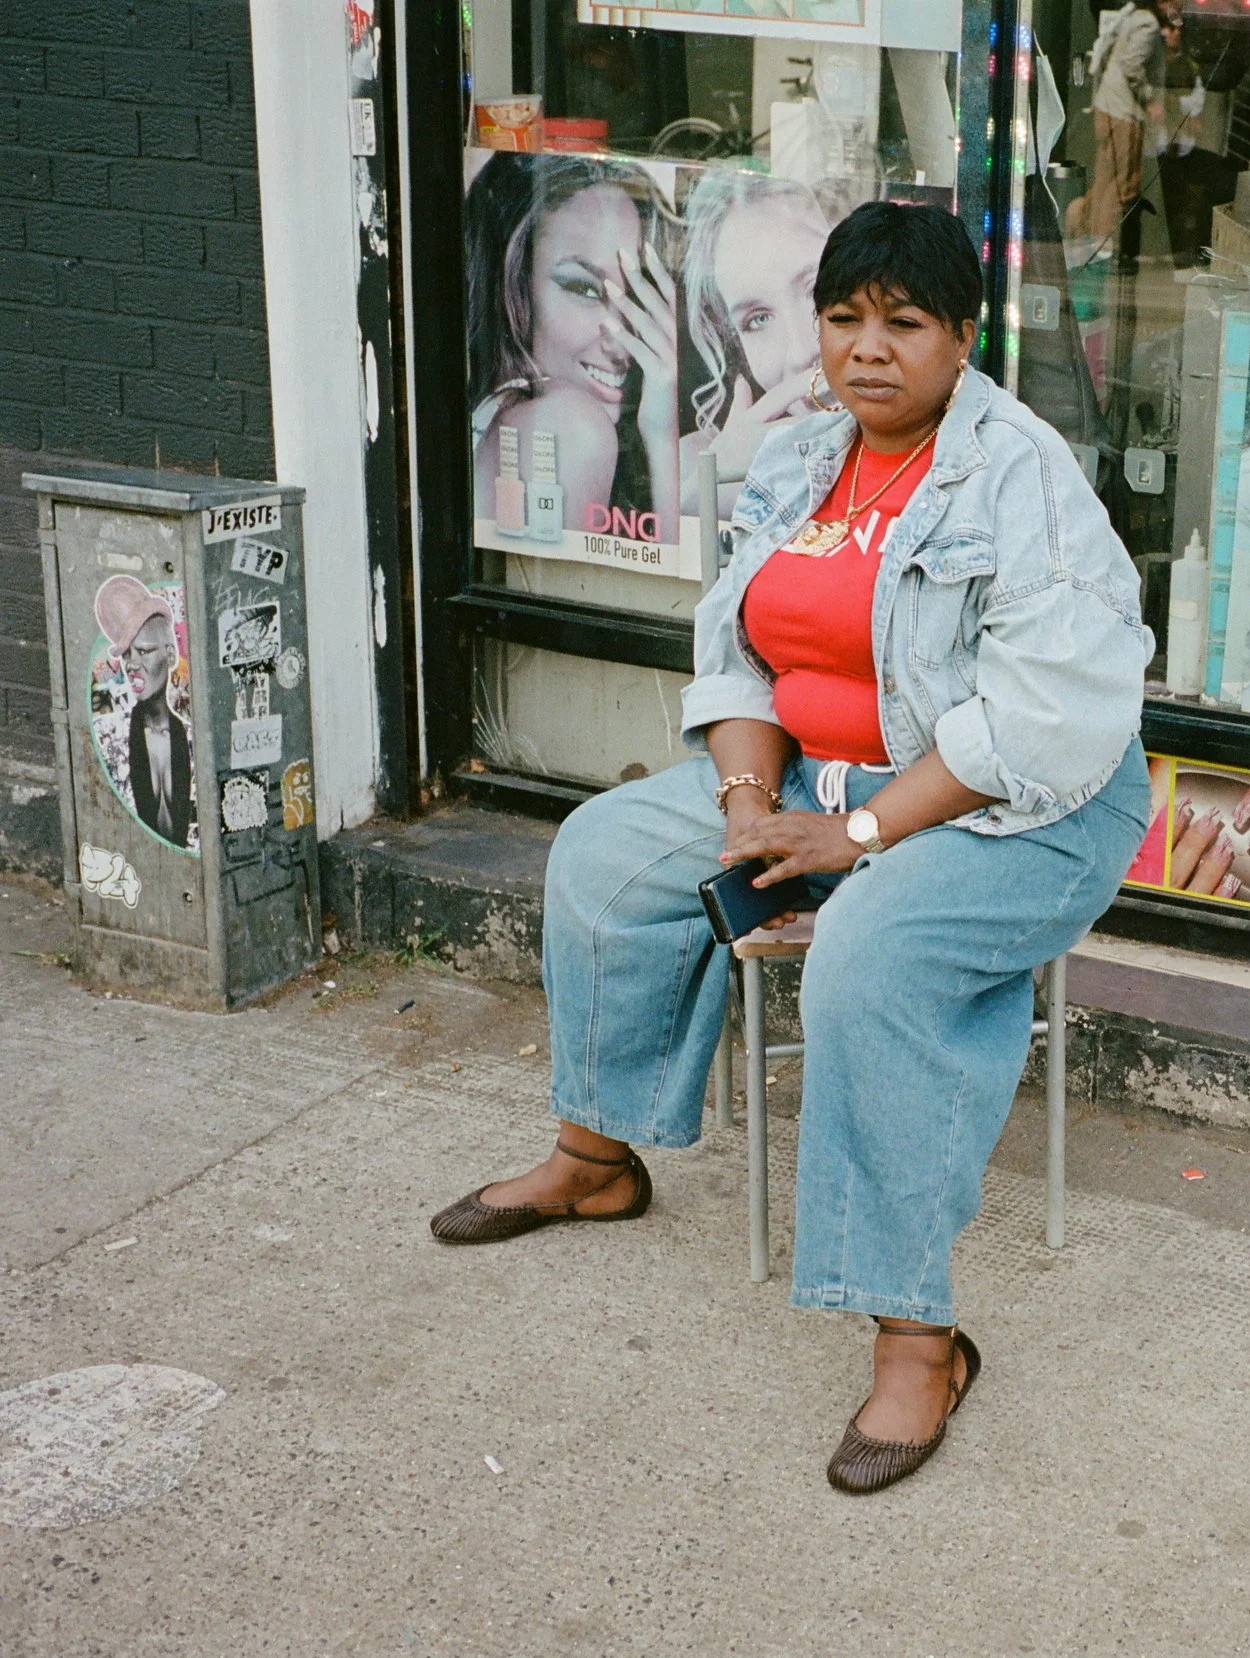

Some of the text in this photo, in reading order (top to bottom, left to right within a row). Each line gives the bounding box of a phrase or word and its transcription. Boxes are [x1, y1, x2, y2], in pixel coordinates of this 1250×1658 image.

[584, 534, 662, 565] 100% Pure Gel
